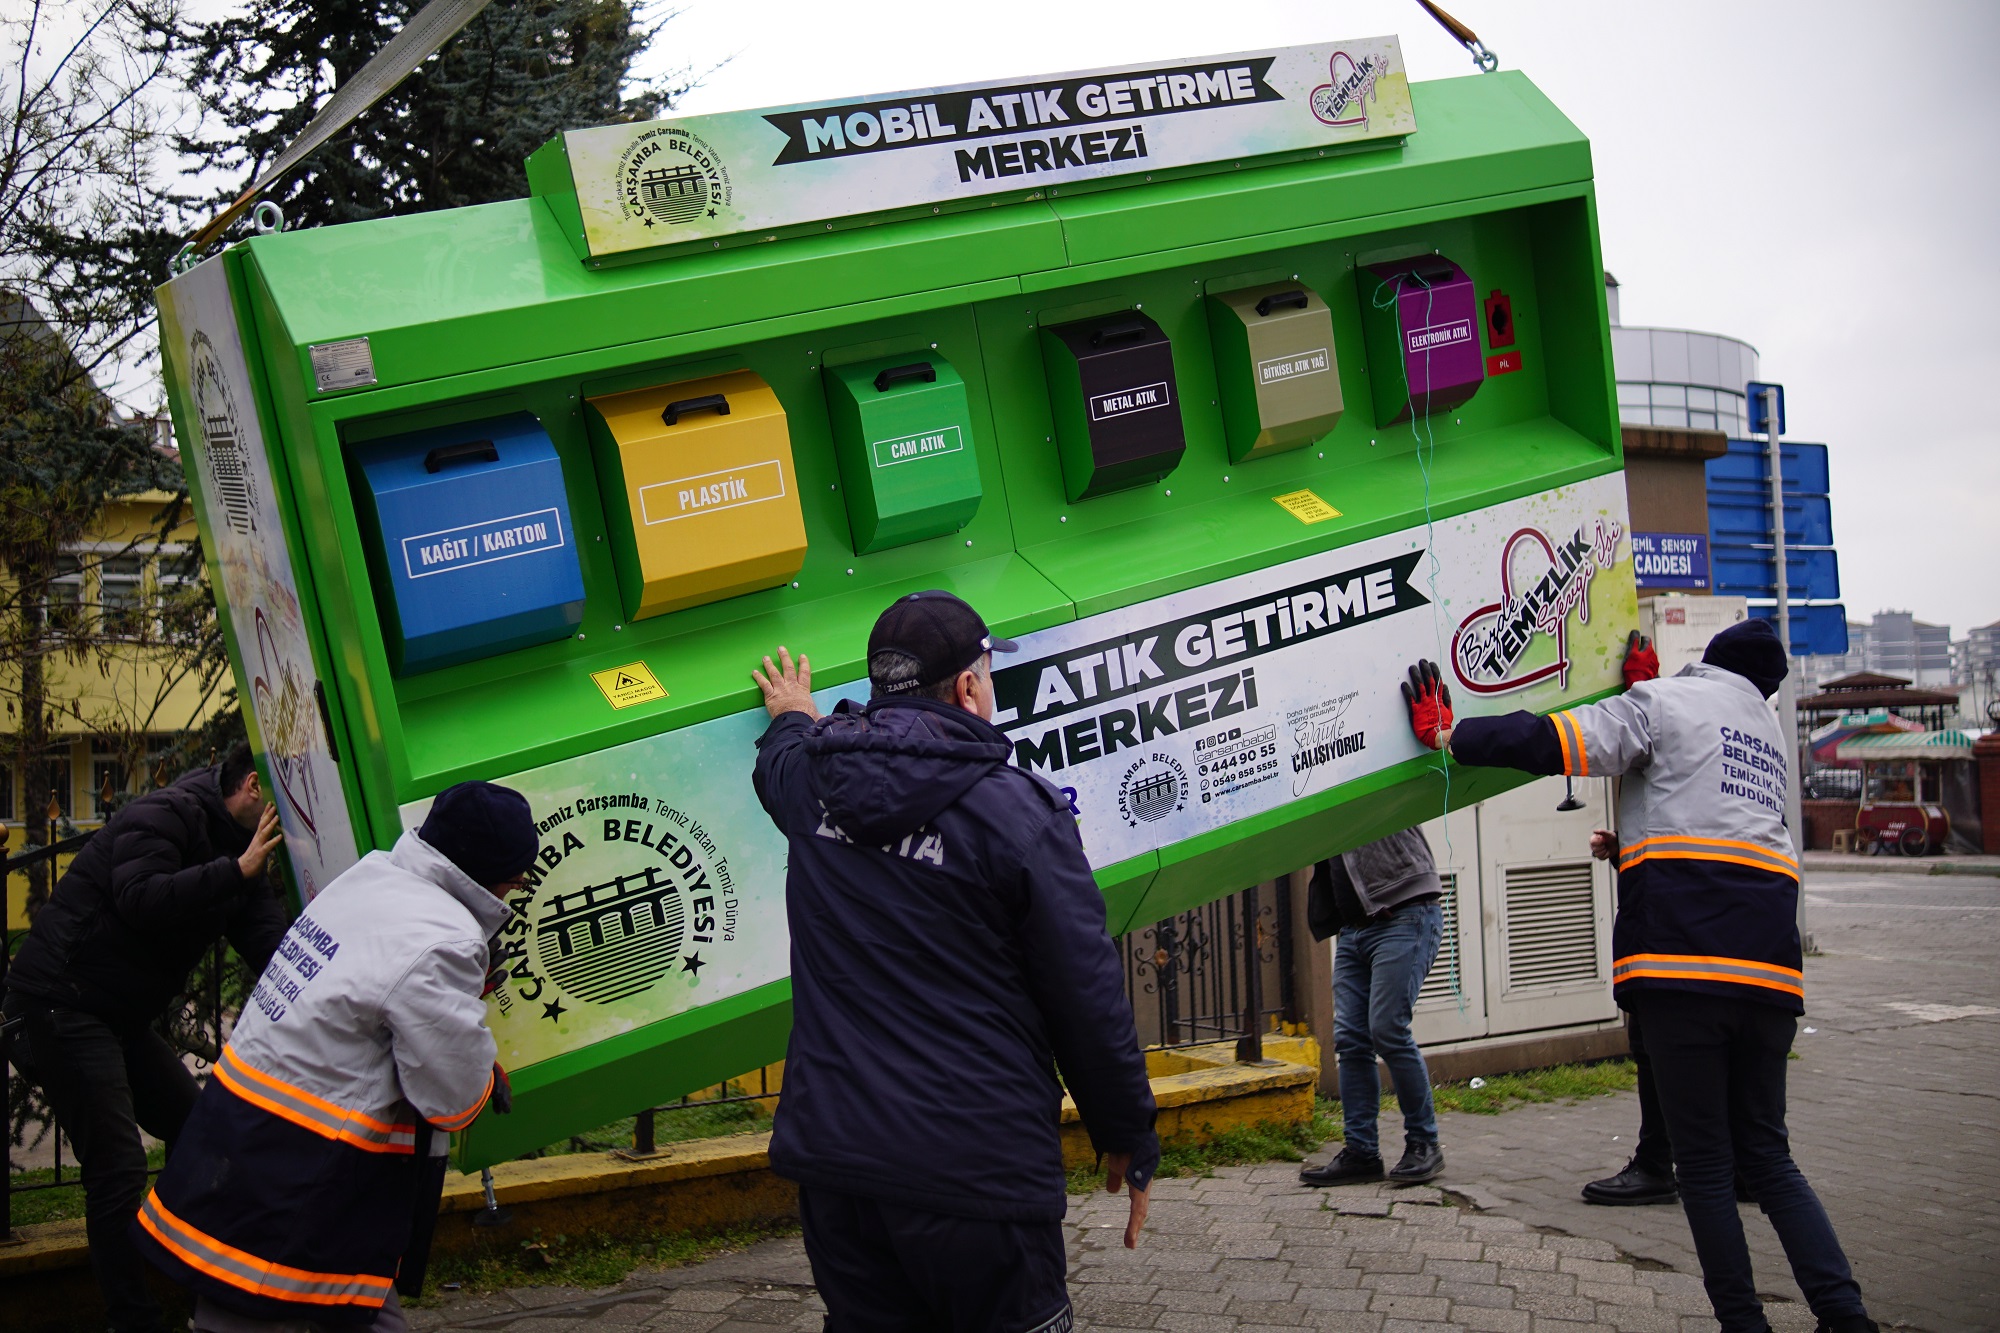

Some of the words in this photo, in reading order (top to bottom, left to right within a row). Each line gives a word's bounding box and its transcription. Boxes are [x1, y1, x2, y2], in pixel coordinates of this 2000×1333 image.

[966, 88, 1070, 132] ATIK
[1076, 66, 1256, 118] GETİRME
[1325, 56, 1373, 119] TEMİZLİK
[954, 124, 1148, 183] MERKEZİ
[626, 142, 662, 217] ÇARŞAMBA
[670, 139, 722, 206] BELEDİYESİ
[1411, 328, 1452, 348] ELEKTRONİK
[1453, 326, 1468, 340] ATIK
[1264, 363, 1294, 380] BİTKİSEL
[1295, 358, 1310, 372] ATIK
[1311, 354, 1325, 369] YAĞ
[1500, 359, 1510, 369] PİL
[1103, 396, 1134, 413] METAL
[1136, 390, 1157, 406] ATIK
[891, 440, 917, 458] CAM
[921, 434, 946, 452] ATIK
[678, 476, 748, 510] PLASTİK
[420, 538, 468, 566] KAĞIT
[482, 522, 547, 552] KARTON
[1632, 536, 1656, 553] EMİL
[1661, 539, 1698, 554] ŞENSOY
[1634, 554, 1692, 576] CADDESİ
[1482, 528, 1592, 678] TEMİZLİK
[1536, 562, 1593, 633] Sevgi
[1033, 636, 1165, 714] ATIK
[1174, 568, 1397, 667] GETİRME
[886, 679, 920, 692] ZABITA
[1322, 698, 1336, 707] daha
[1014, 666, 1259, 772] MERKEZİ
[1260, 743, 1276, 758] 55
[1118, 758, 1146, 820] ÇARŞAMBA
[1152, 753, 1188, 800] BELEDİYESİ
[1212, 774, 1236, 788] 0549
[1238, 767, 1254, 778] 858
[1256, 760, 1278, 772] 5555
[1722, 762, 1773, 793] TEMİZLİK
[576, 793, 650, 816] Çarşamba,
[656, 799, 689, 828] Temiz
[1720, 781, 1782, 814] MÜDÜRL
[689, 820, 717, 859] Vatan,
[714, 856, 735, 897] Temiz
[505, 832, 585, 1001] ÇARŞAMBA
[604, 819, 715, 943] BELEDİYESİ
[724, 898, 739, 942] Dünya
[292, 914, 340, 962] ARŞAMBA
[278, 934, 324, 982] ELEDİYESİ
[252, 983, 286, 1022] DÜRLÜĞÜ
